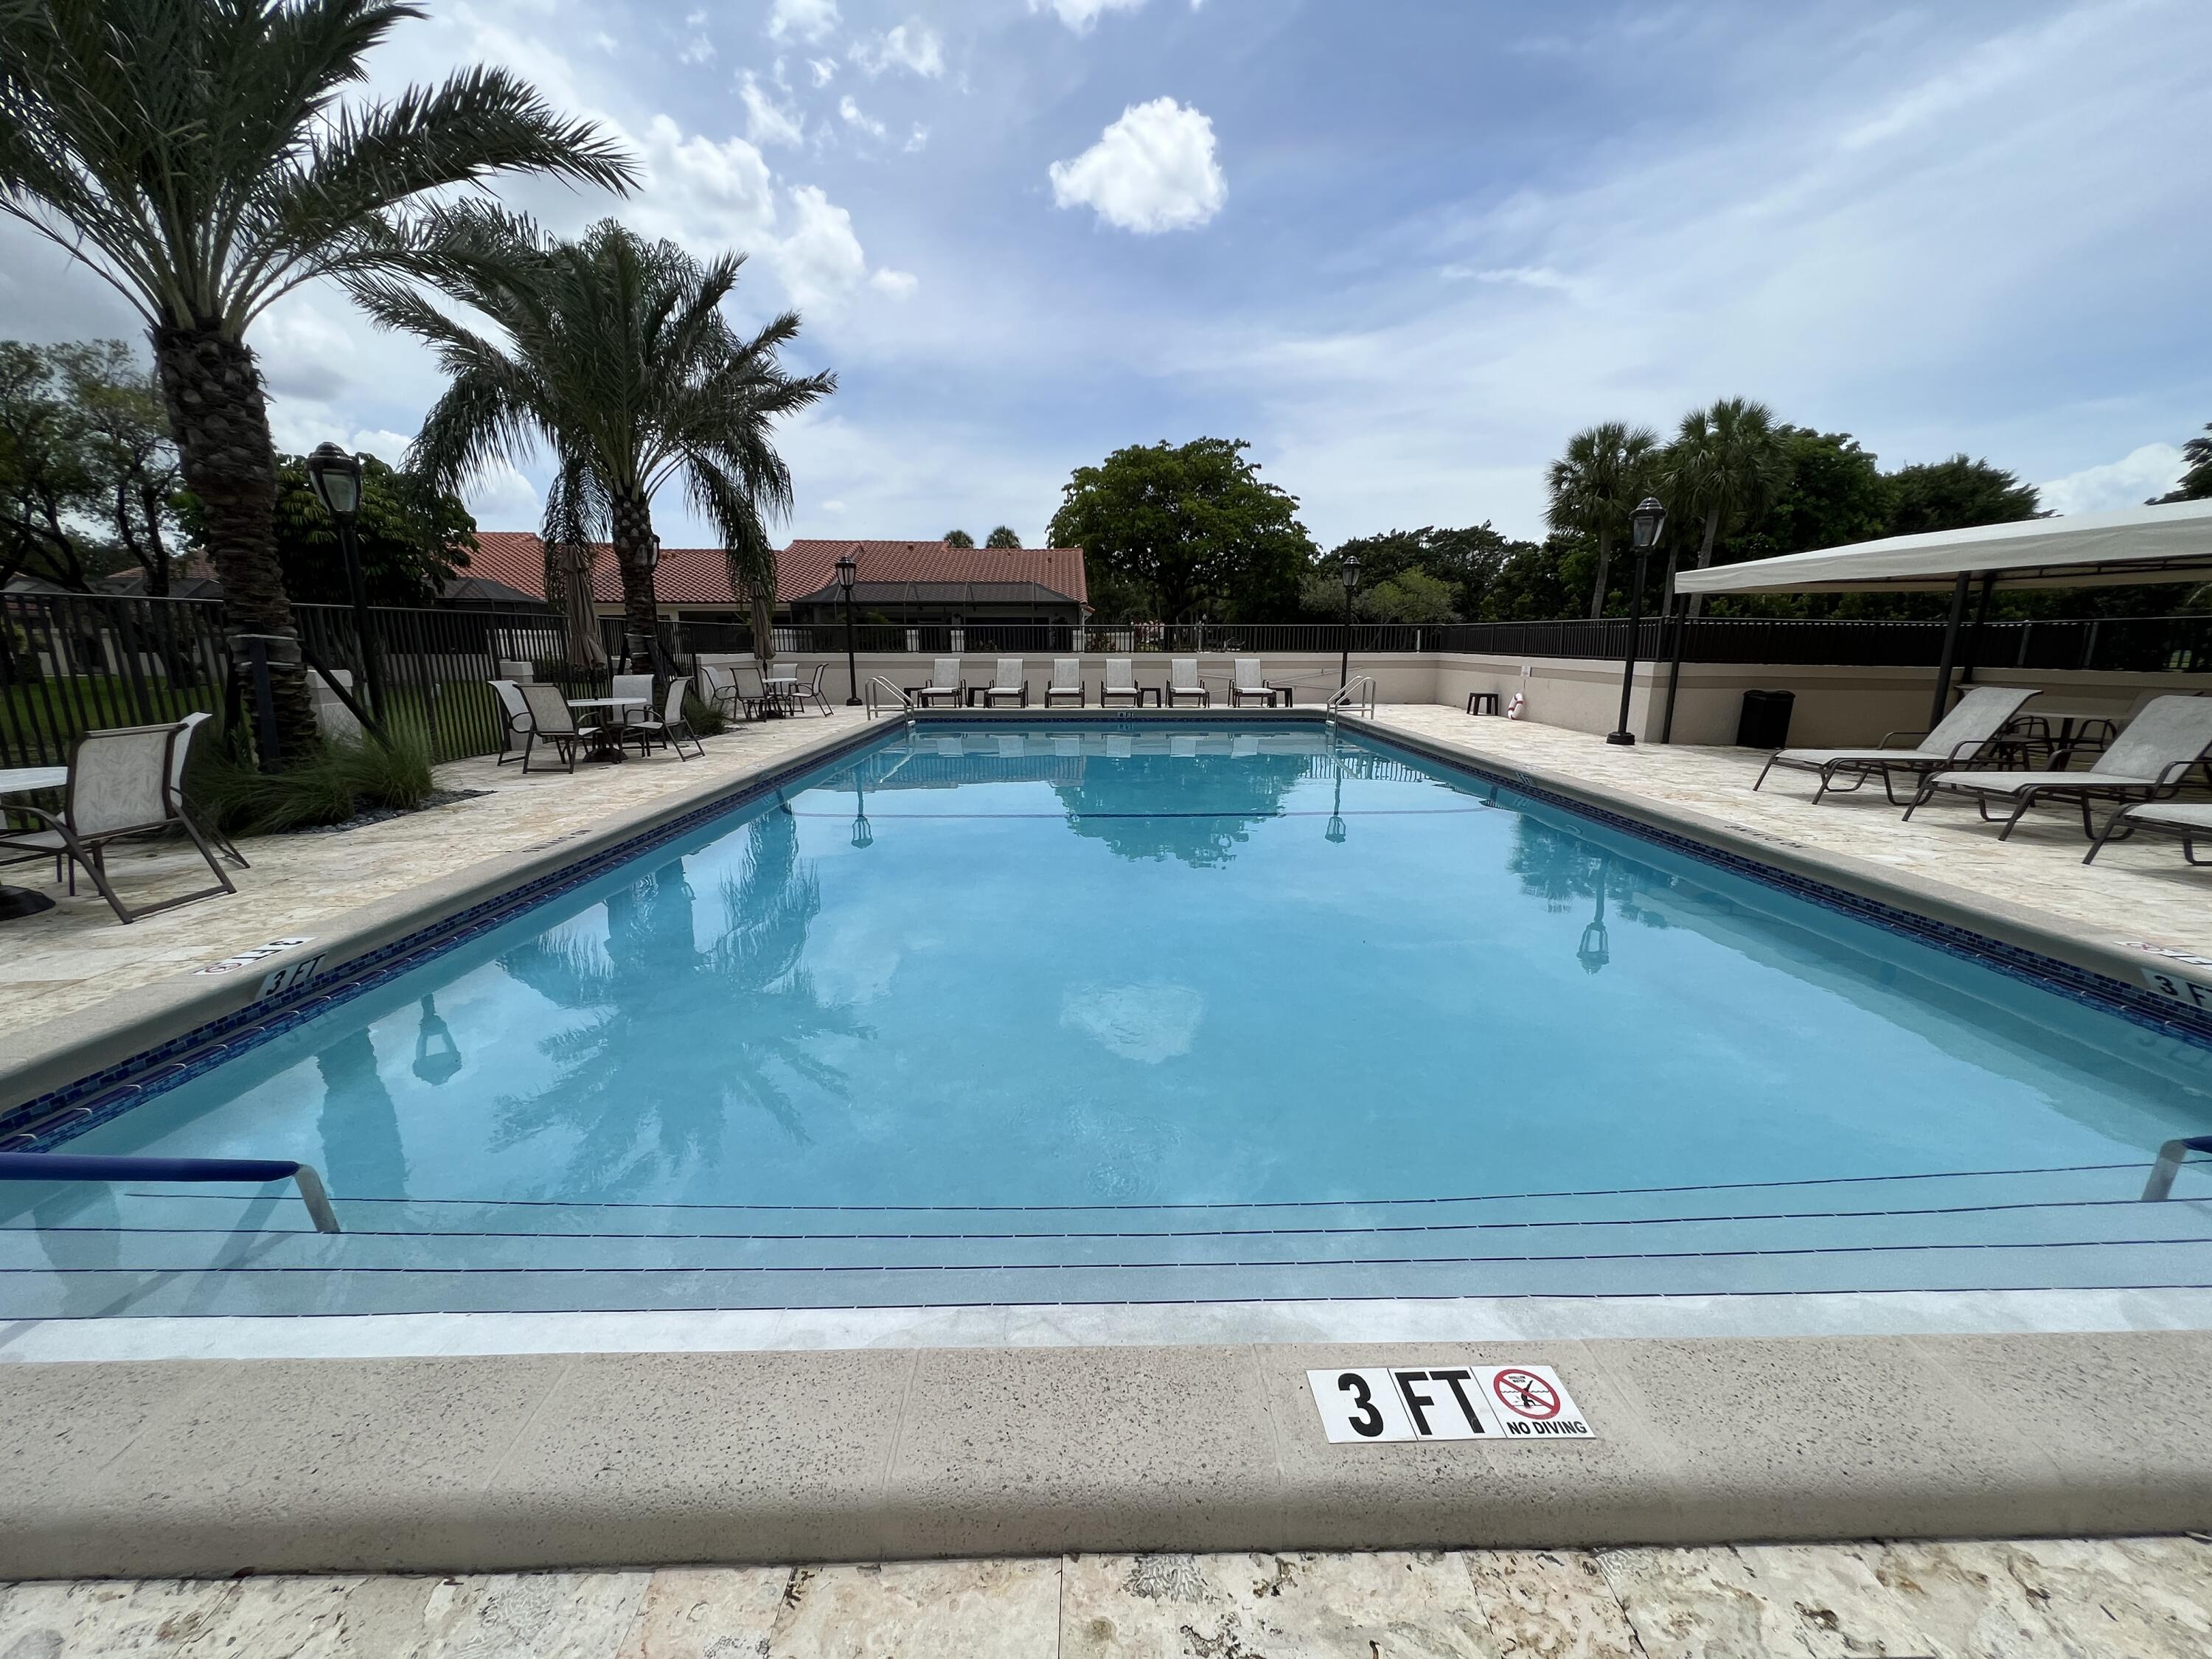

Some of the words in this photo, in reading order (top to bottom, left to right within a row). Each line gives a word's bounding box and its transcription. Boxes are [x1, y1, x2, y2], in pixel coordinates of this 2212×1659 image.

[231, 949, 282, 960] FT
[265, 970, 287, 995] 3
[288, 953, 326, 986] FT
[2154, 975, 2178, 995] 3
[2185, 981, 2212, 1006] F
[1338, 1373, 1384, 1437] 3
[1394, 1370, 1486, 1436] FT
[1506, 1422, 1531, 1434] NO
[1531, 1422, 1587, 1434] DIVING
